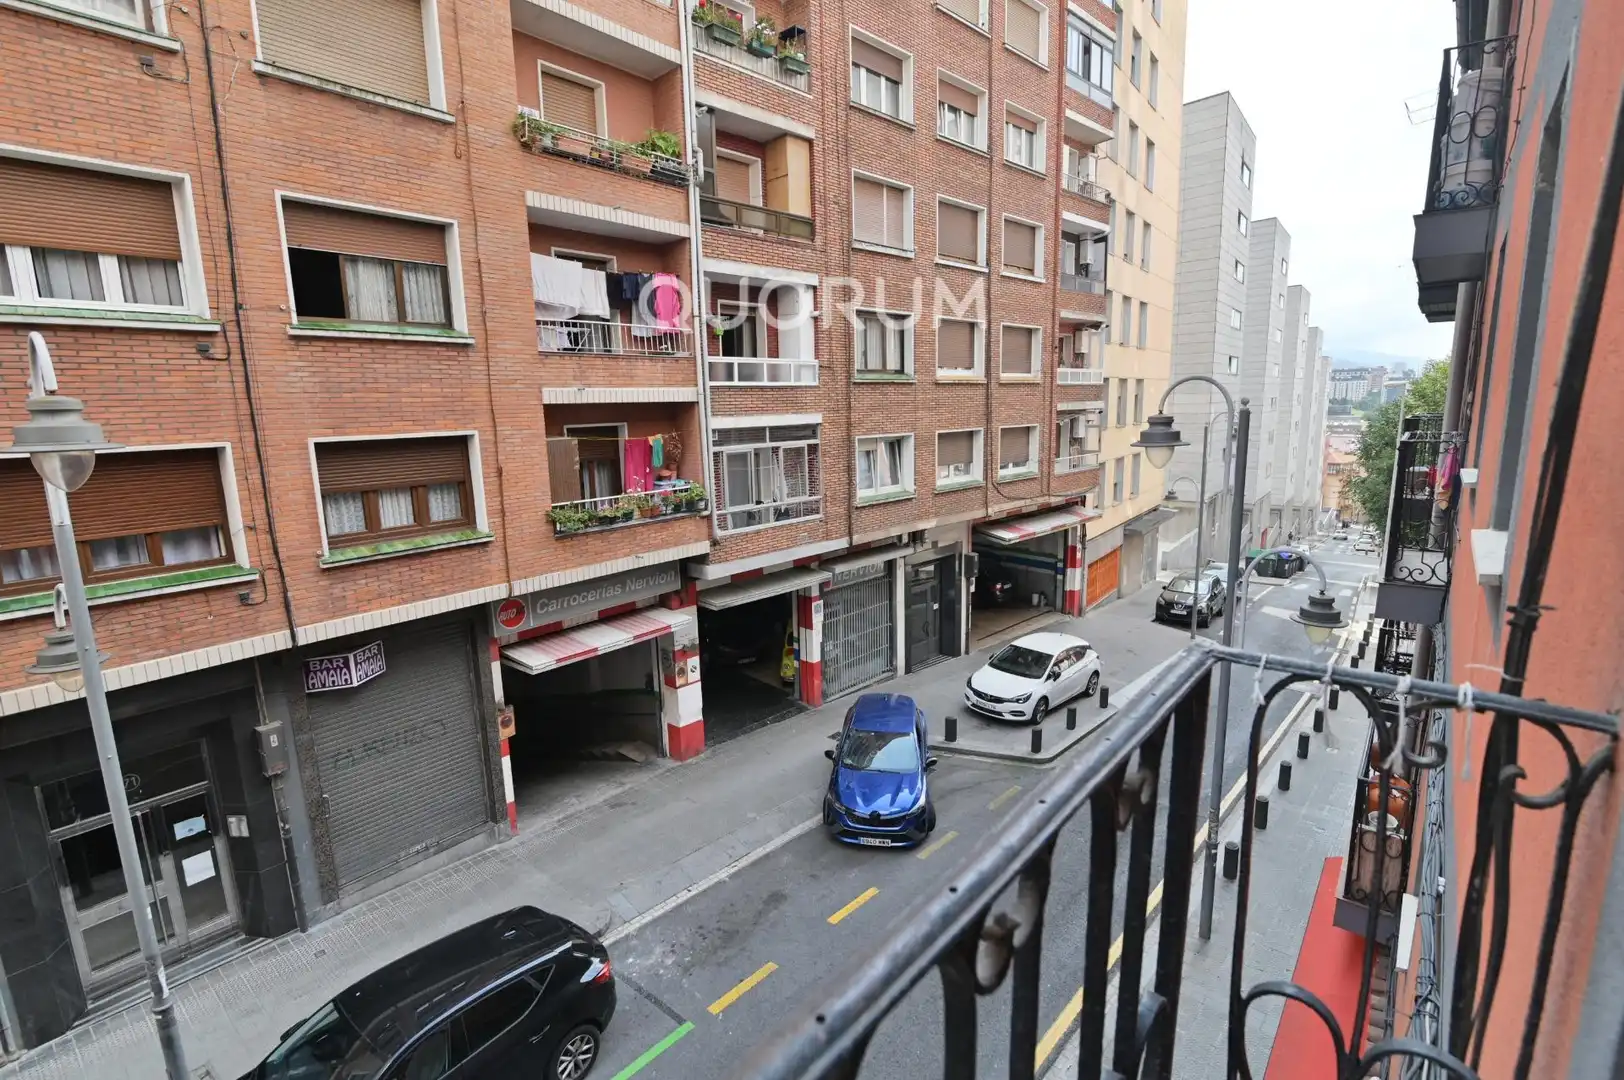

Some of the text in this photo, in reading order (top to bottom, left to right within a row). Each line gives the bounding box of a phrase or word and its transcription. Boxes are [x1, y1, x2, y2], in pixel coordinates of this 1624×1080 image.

[536, 583, 622, 614] Carrocerías
[625, 571, 676, 592] Nervion
[309, 657, 345, 671] BAR
[357, 645, 379, 663] BAR
[308, 667, 351, 690] AMAIA
[356, 654, 383, 682] AMAIA
